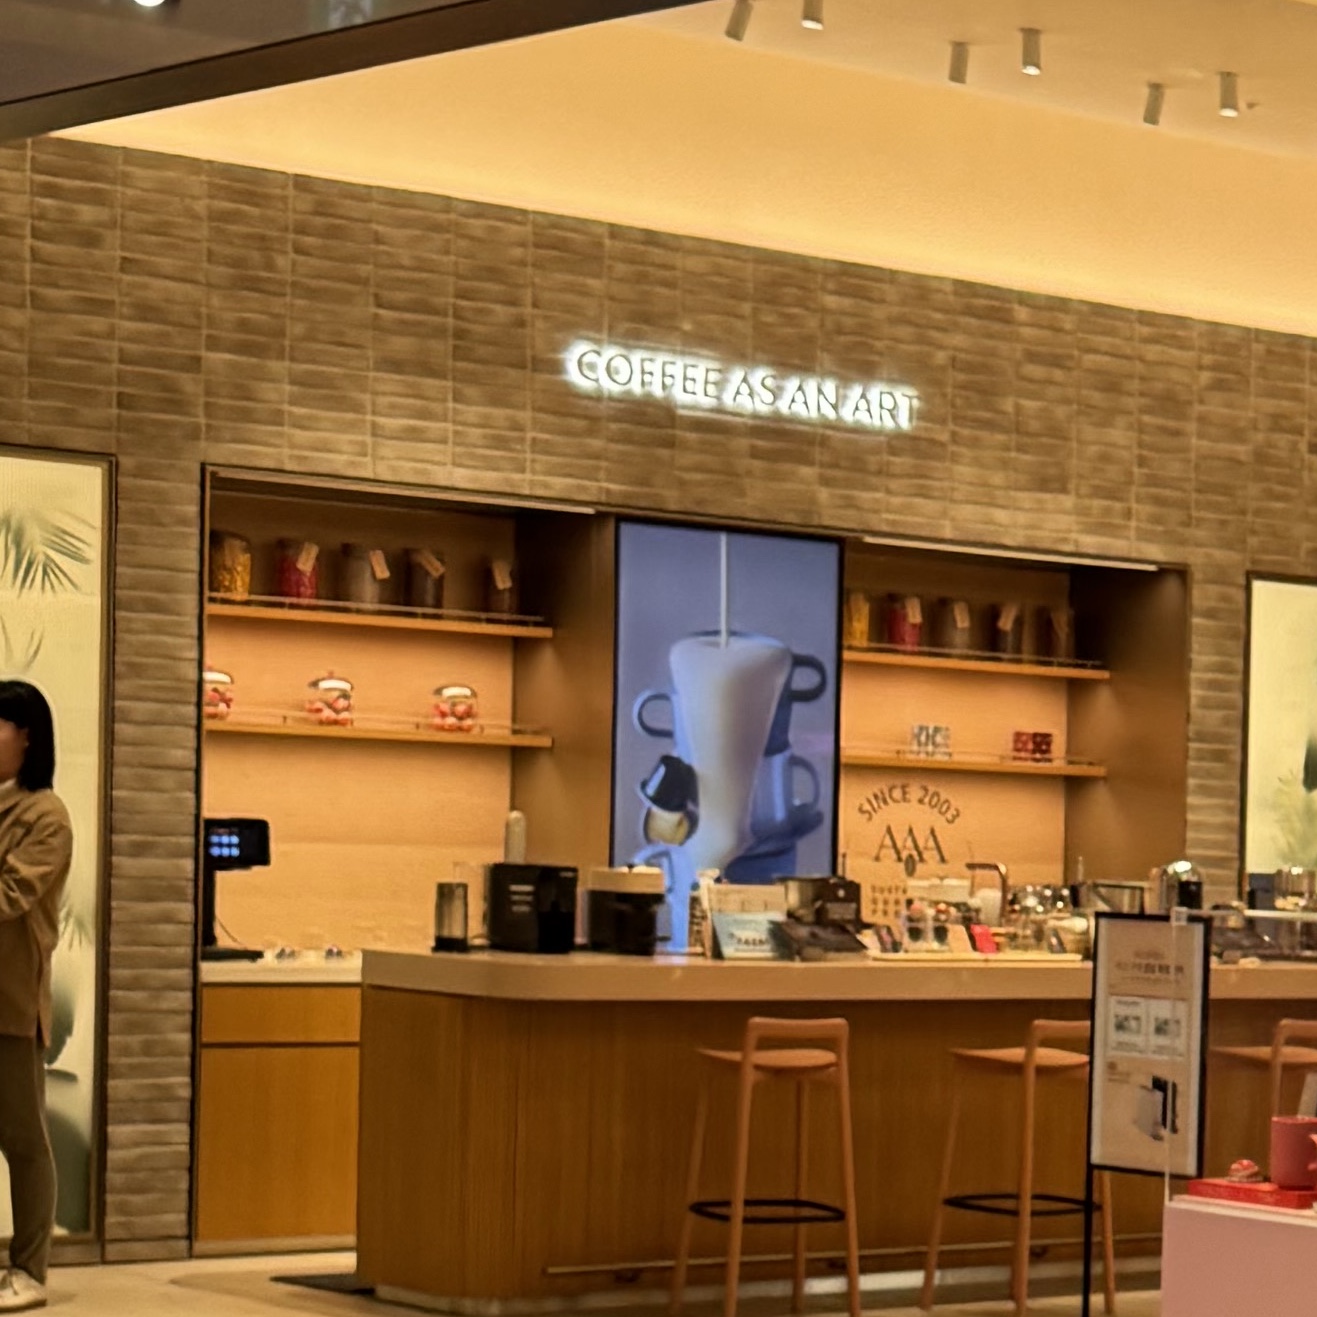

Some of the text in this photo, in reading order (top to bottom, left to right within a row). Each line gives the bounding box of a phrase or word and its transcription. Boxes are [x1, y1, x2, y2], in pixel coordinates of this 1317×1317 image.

[577, 348, 921, 429] COFFEE AS AN ART
[858, 783, 960, 824] SINCE 2003
